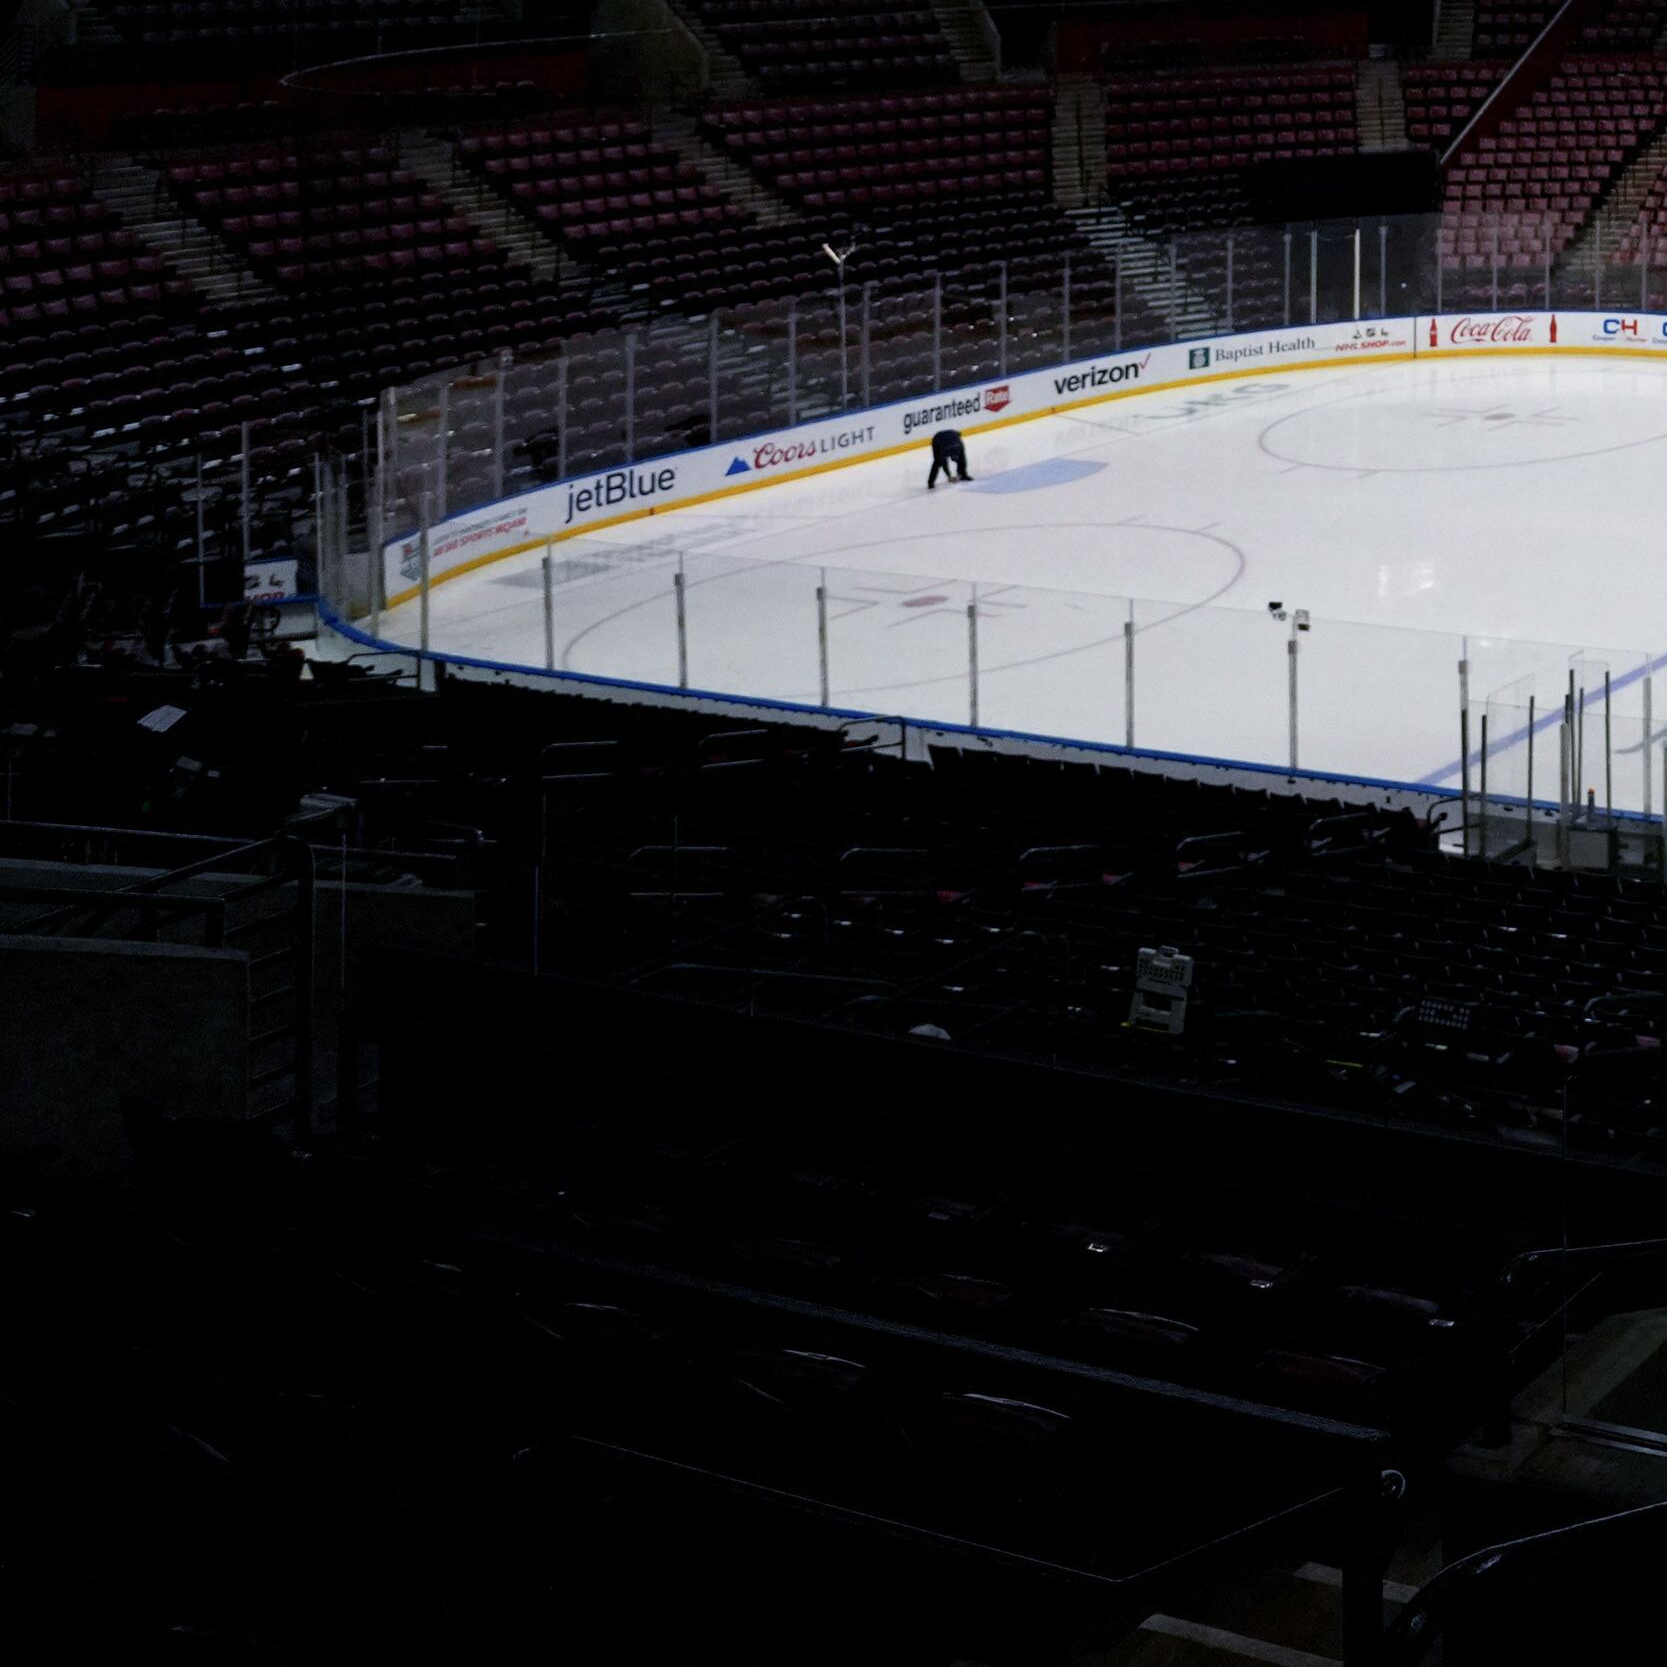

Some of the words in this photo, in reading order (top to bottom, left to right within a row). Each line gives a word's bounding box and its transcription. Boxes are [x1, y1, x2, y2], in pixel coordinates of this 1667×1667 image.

[1451, 315, 1534, 344] Coca-Cola
[1603, 319, 1637, 335] CH
[1215, 343, 1263, 362] Baptist
[1268, 336, 1316, 355] Health
[1054, 361, 1139, 395] verizon
[904, 392, 981, 434] guaranteed
[754, 440, 817, 470] Coors
[820, 426, 876, 453] LIGHT
[566, 467, 675, 524] jetBlue
